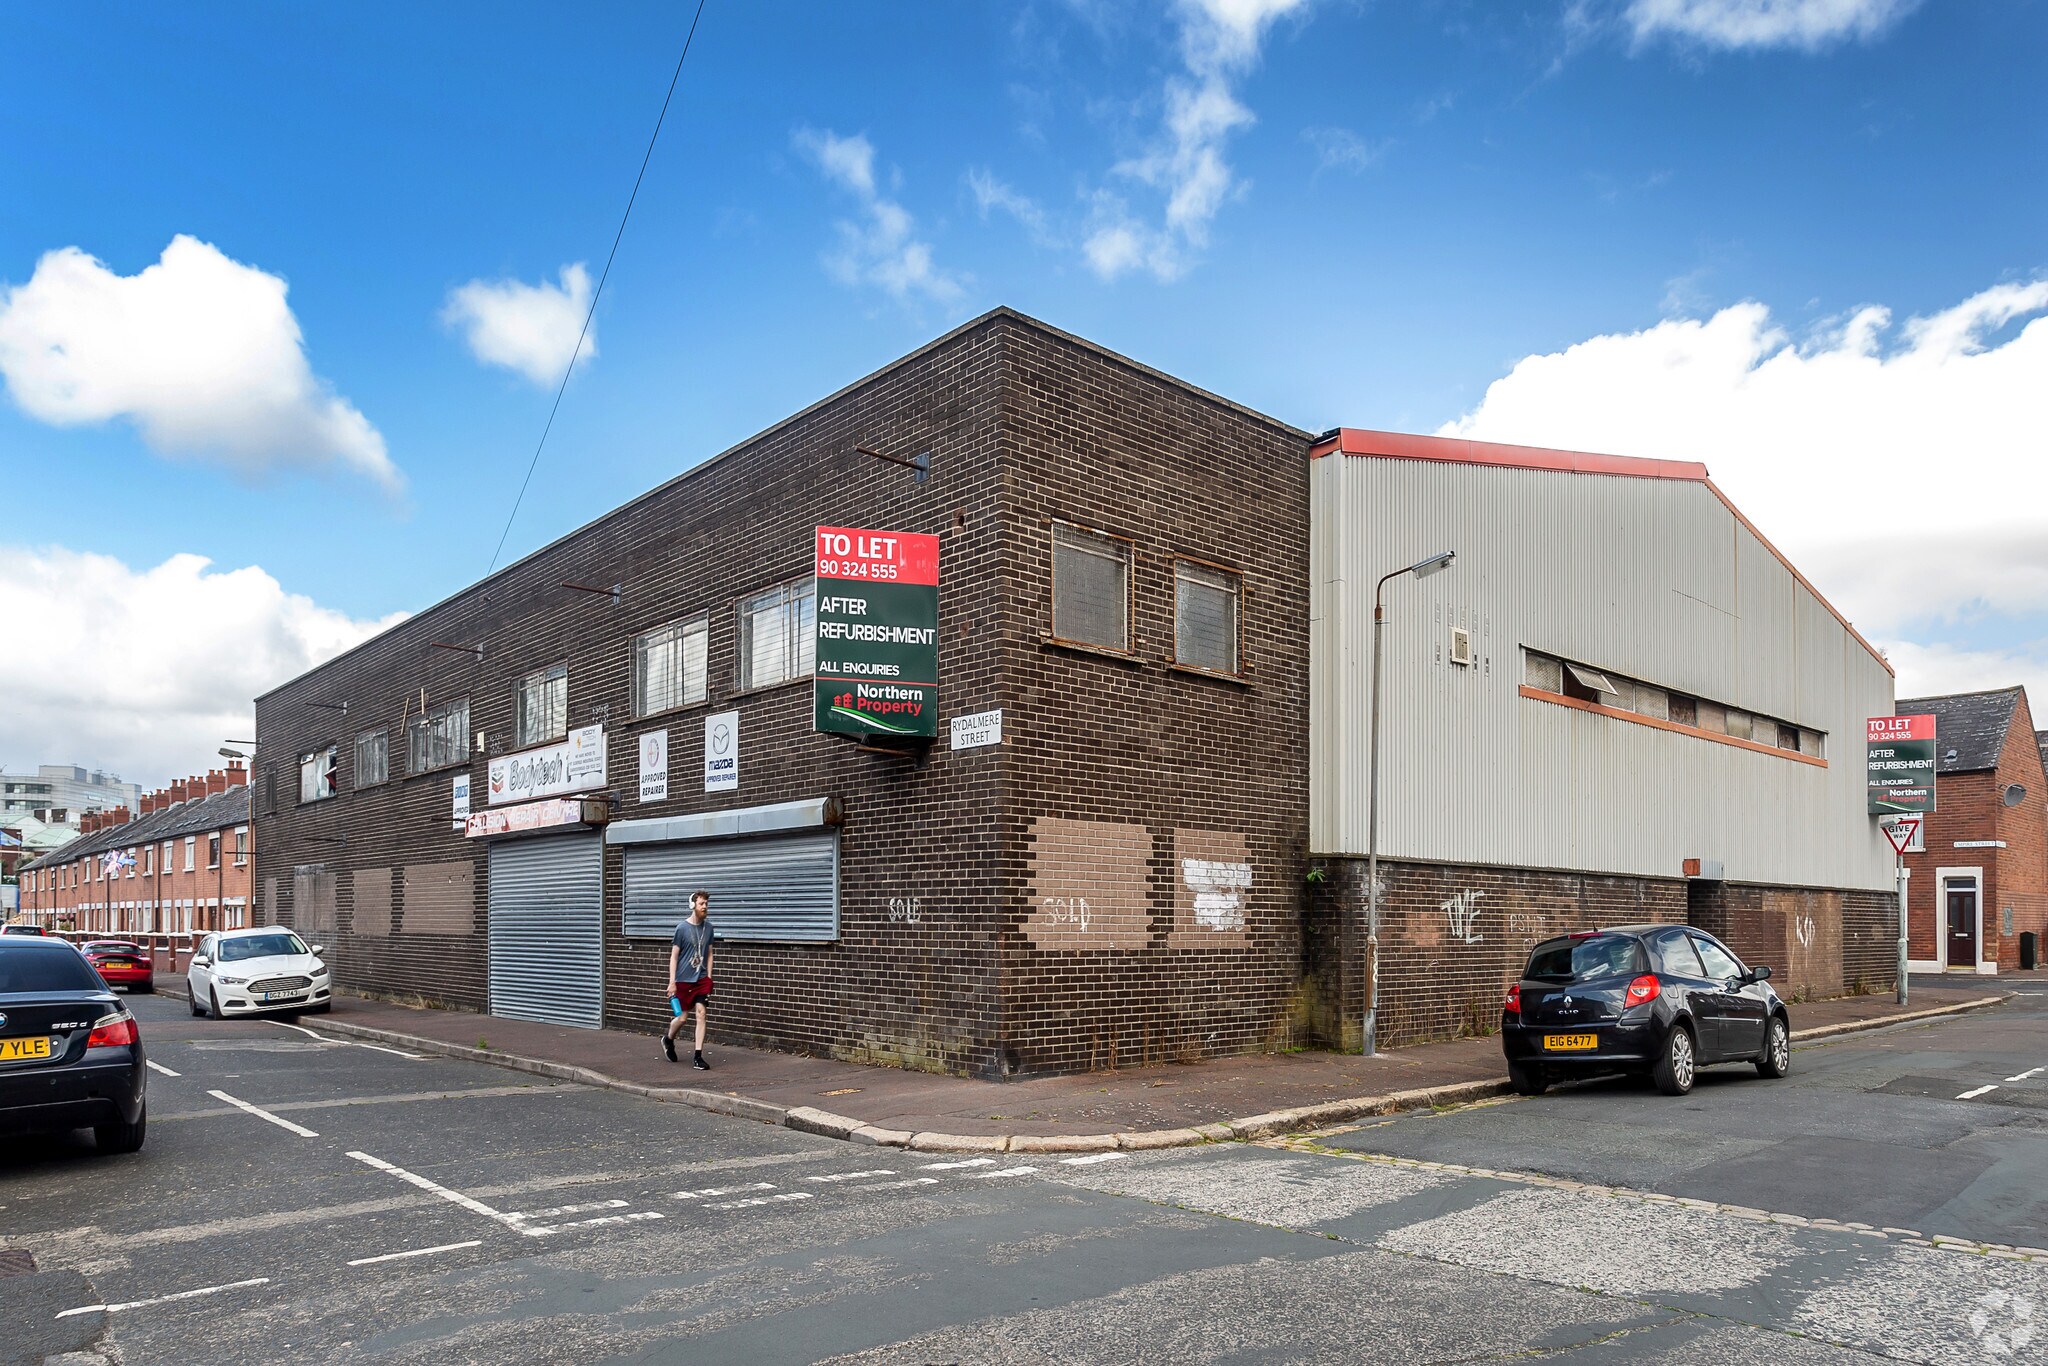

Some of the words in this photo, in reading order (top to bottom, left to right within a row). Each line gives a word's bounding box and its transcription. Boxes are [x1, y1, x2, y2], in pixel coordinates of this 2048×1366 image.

[820, 533, 851, 556] TO
[858, 536, 897, 559] LET
[820, 559, 838, 574] 90
[841, 561, 867, 577] 324
[871, 563, 897, 579] 555
[820, 596, 867, 615] AFTER
[819, 621, 935, 645] REFURBISHMENT
[819, 660, 840, 673] ALL
[843, 662, 900, 676] ENQUIRIES
[857, 683, 923, 701] Northern
[857, 697, 922, 717] Property
[952, 713, 1000, 733] RYDALMERE
[1868, 720, 1886, 732] TO
[1889, 719, 1911, 731] LET
[960, 730, 990, 746] STREET
[1880, 732, 1895, 740] 324
[1896, 731, 1912, 739] 555
[1869, 749, 1895, 758] AFTER
[709, 758, 733, 771] mazda
[1868, 759, 1933, 771] REFURBISHMENT
[509, 752, 562, 797] Bodytech
[641, 771, 666, 784] APPROVED
[642, 785, 664, 796] REPAIRER
[1888, 825, 1910, 833] GIVE
[10, 1040, 45, 1055] YLE
[1550, 1036, 1564, 1046] EIG
[1567, 1036, 1591, 1046] 6477
